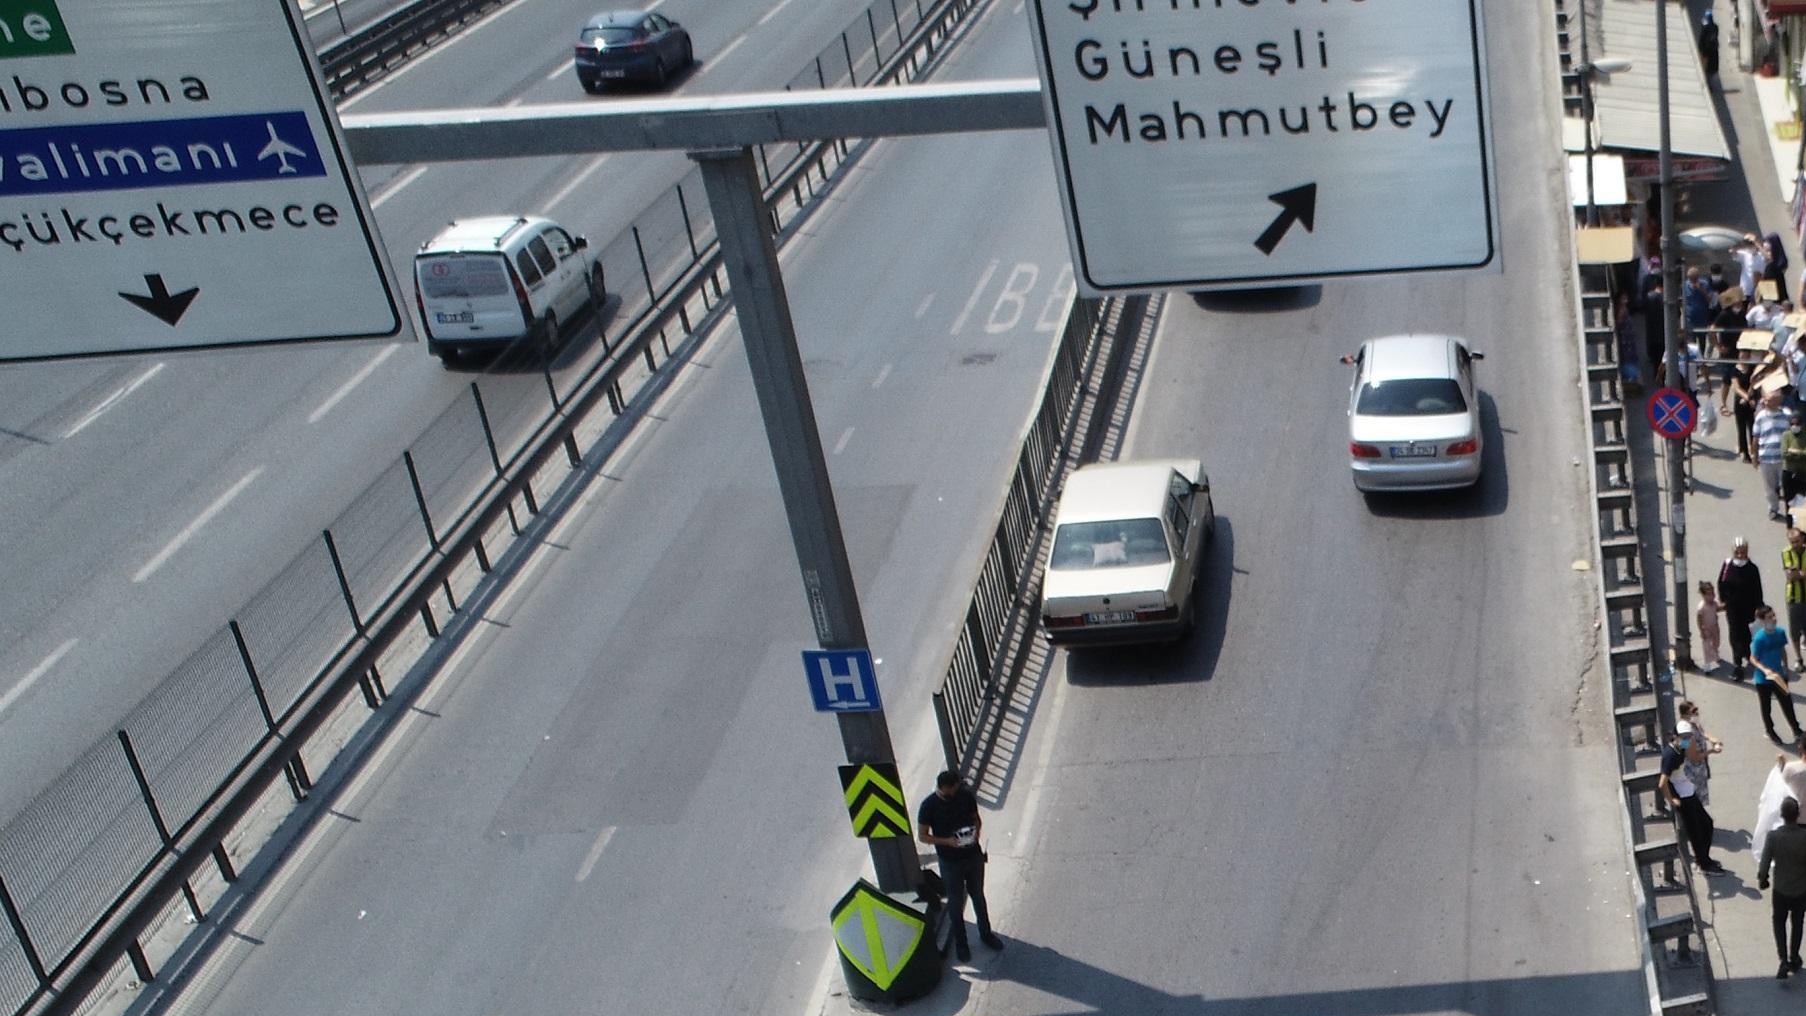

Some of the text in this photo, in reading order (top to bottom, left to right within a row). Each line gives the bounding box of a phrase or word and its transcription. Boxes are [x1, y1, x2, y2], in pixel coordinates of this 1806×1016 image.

[1074, 29, 1330, 82] Güneşli
[1083, 92, 1455, 146] Mahmutbey
[0, 142, 238, 182] alimanı
[818, 656, 867, 702] H
